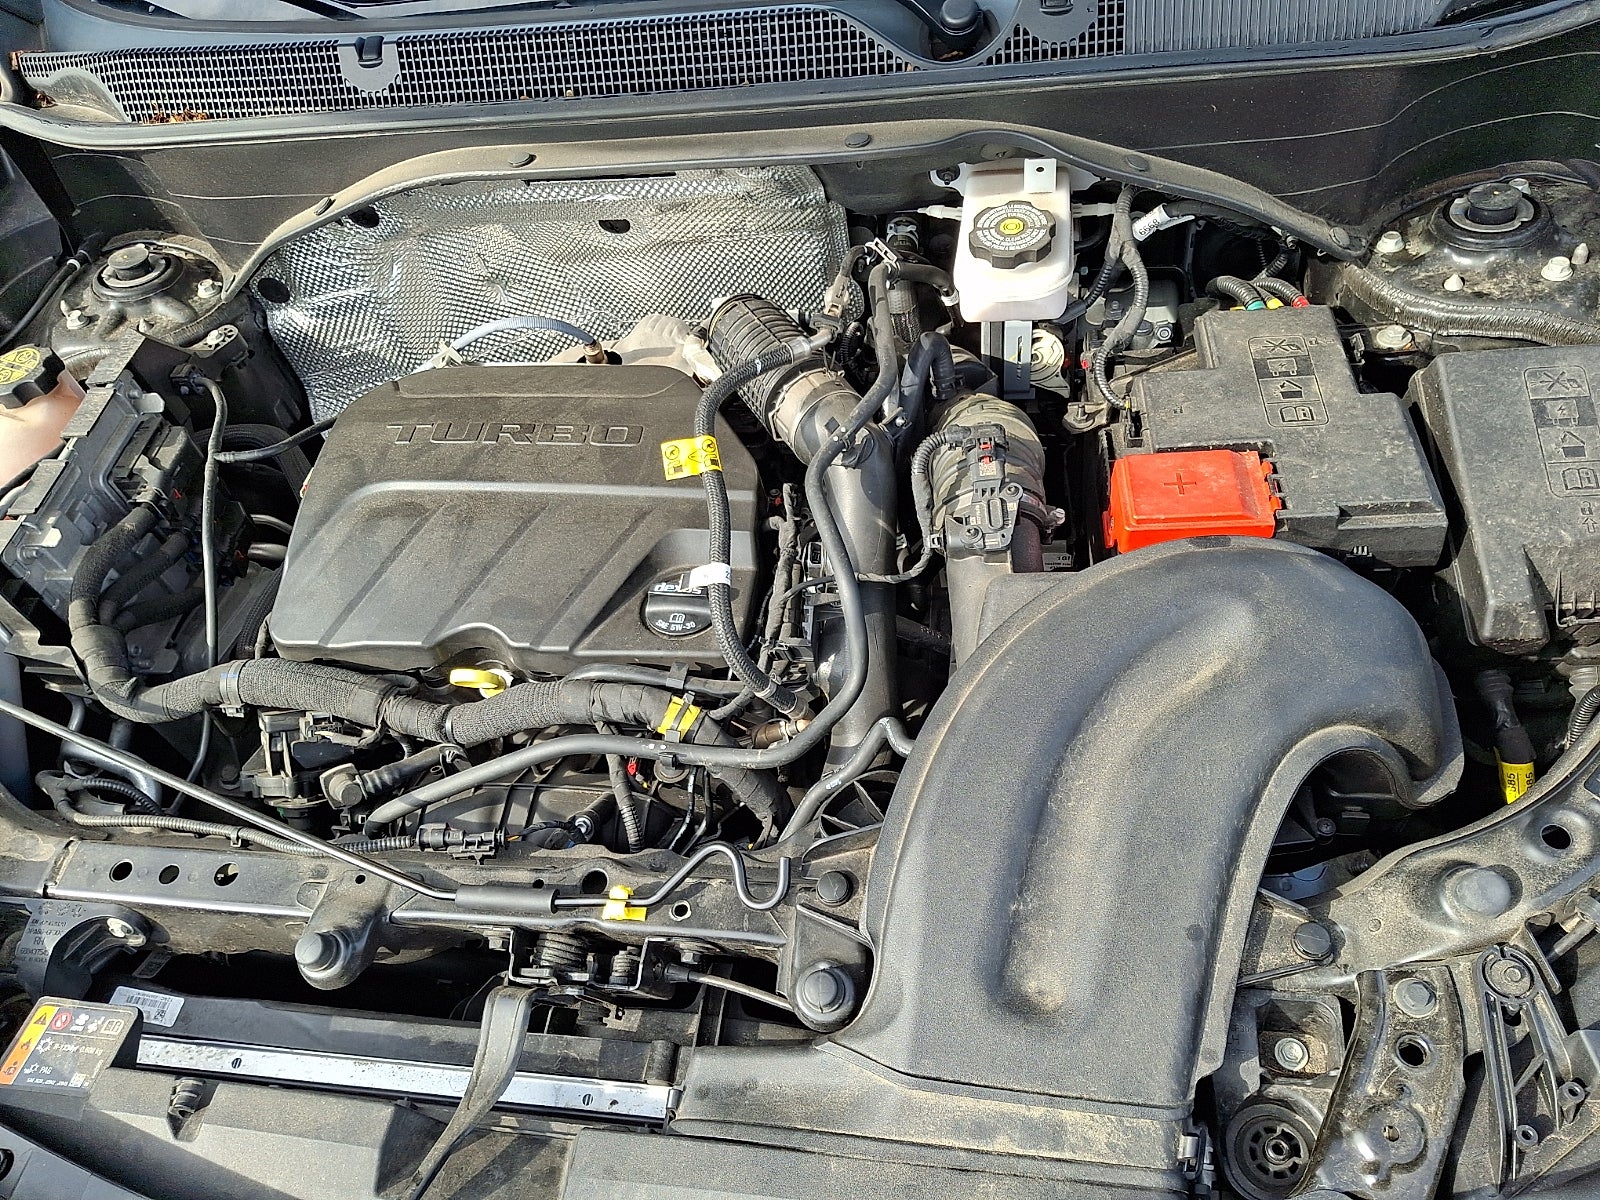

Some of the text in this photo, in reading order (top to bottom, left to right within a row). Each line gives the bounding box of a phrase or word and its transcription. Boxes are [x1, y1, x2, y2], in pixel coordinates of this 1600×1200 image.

[386, 421, 645, 447] TURBO
[670, 621, 696, 631] 5W-30
[38, 1065, 53, 1075] PAG
